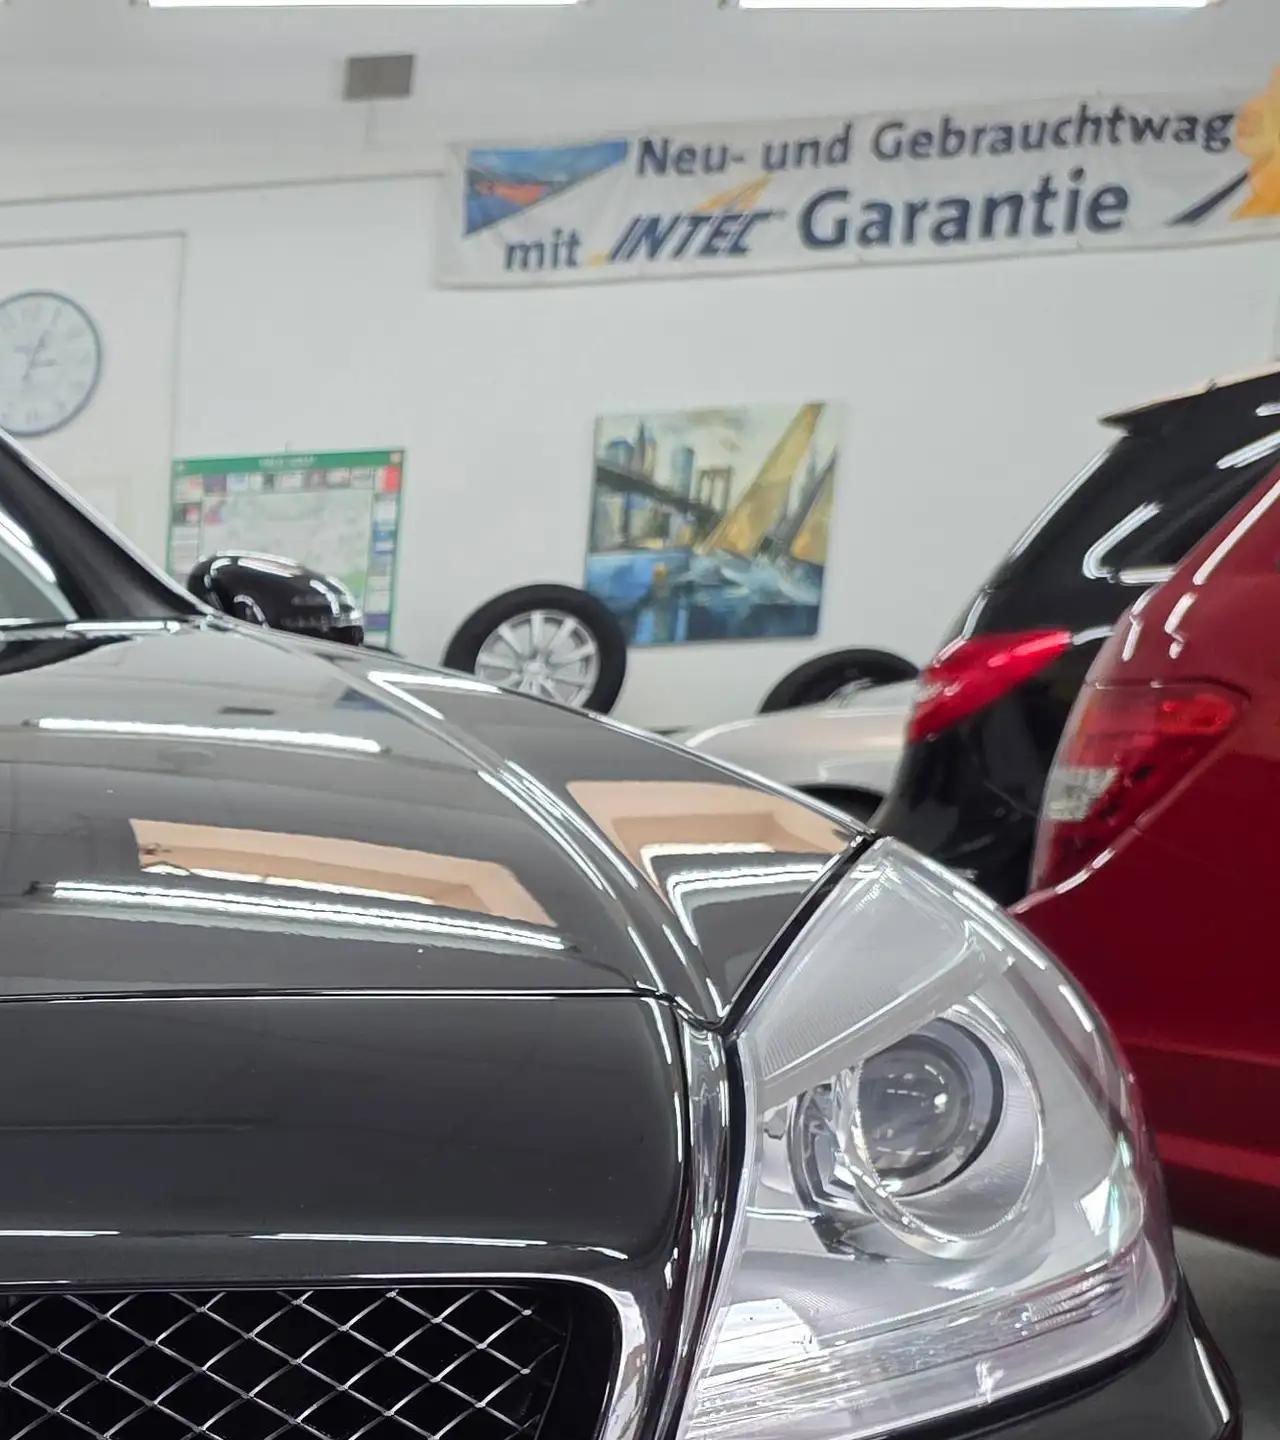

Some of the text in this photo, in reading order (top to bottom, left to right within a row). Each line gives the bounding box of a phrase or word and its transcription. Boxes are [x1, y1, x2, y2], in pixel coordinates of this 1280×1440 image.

[637, 101, 1235, 178] Neu- und Gebrauchtwag
[504, 166, 1130, 272] mit INTEC Garantie
